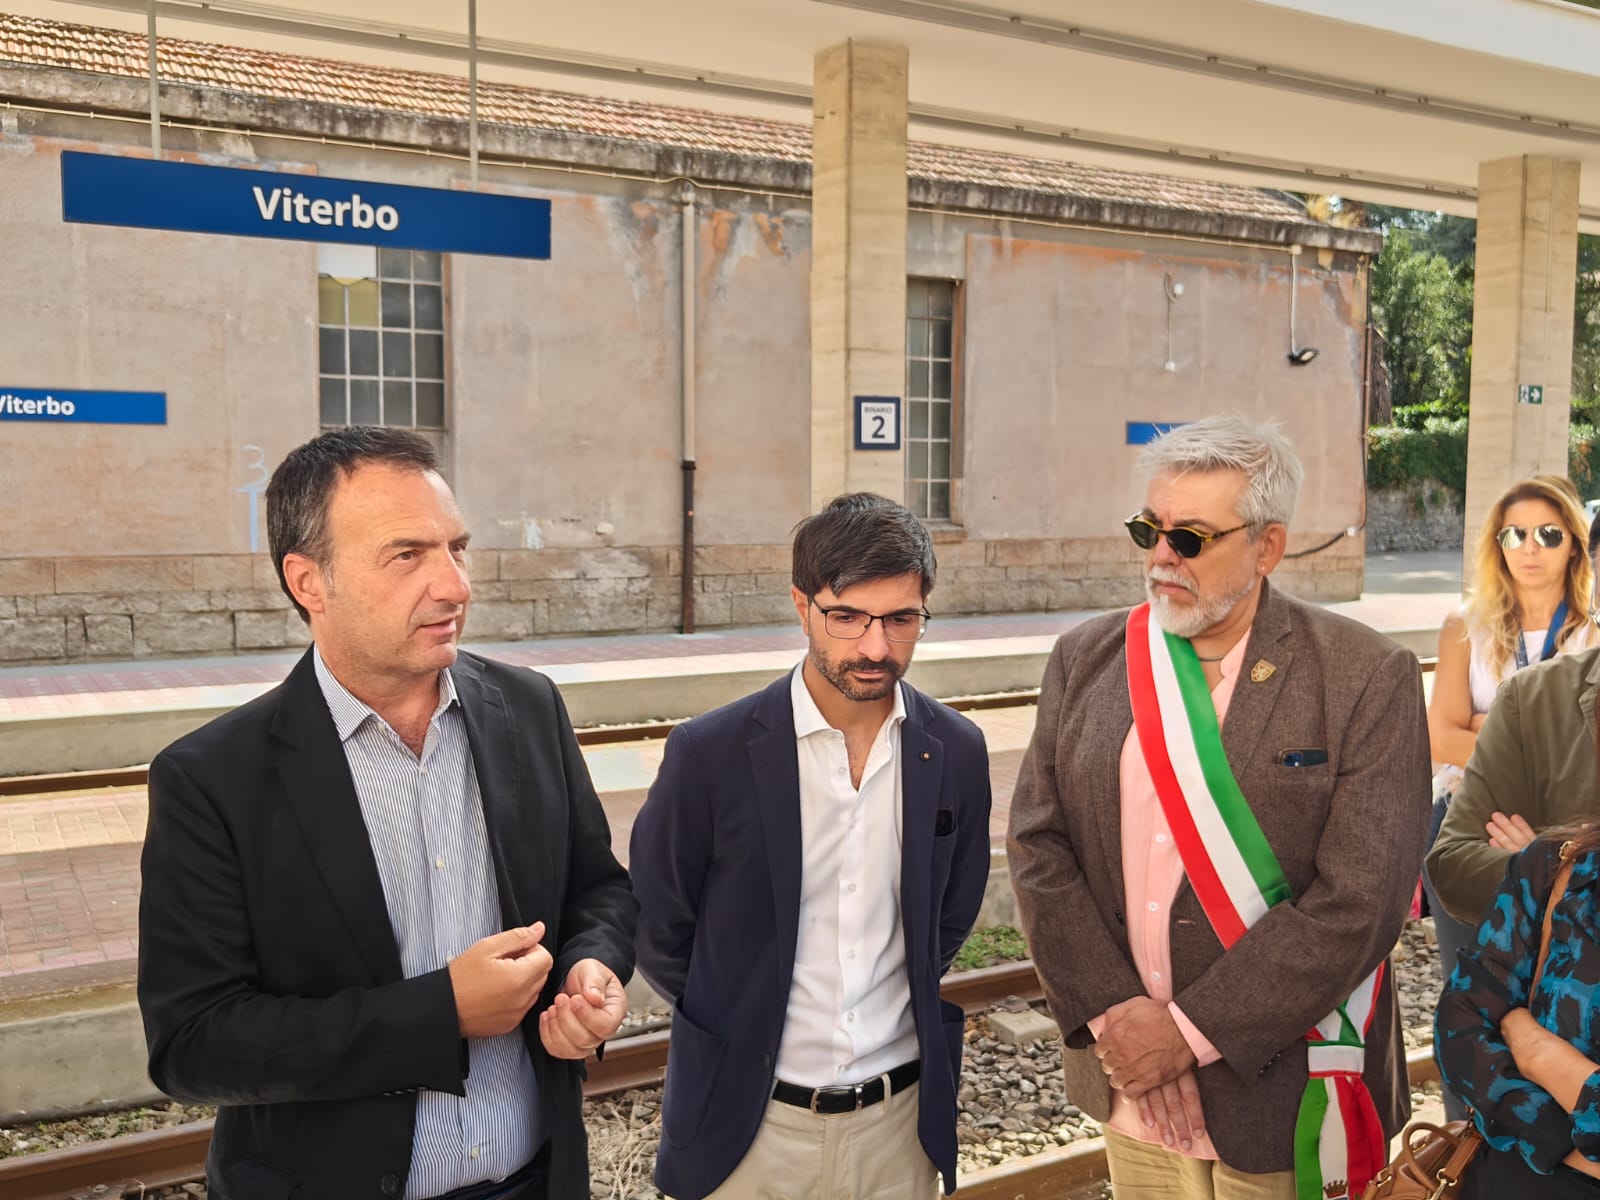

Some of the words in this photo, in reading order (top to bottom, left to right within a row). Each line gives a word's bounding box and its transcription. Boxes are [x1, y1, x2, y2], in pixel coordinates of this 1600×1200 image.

[252, 186, 399, 231] Viterbo
[864, 406, 892, 414] BINARIO
[871, 415, 885, 439] 2
